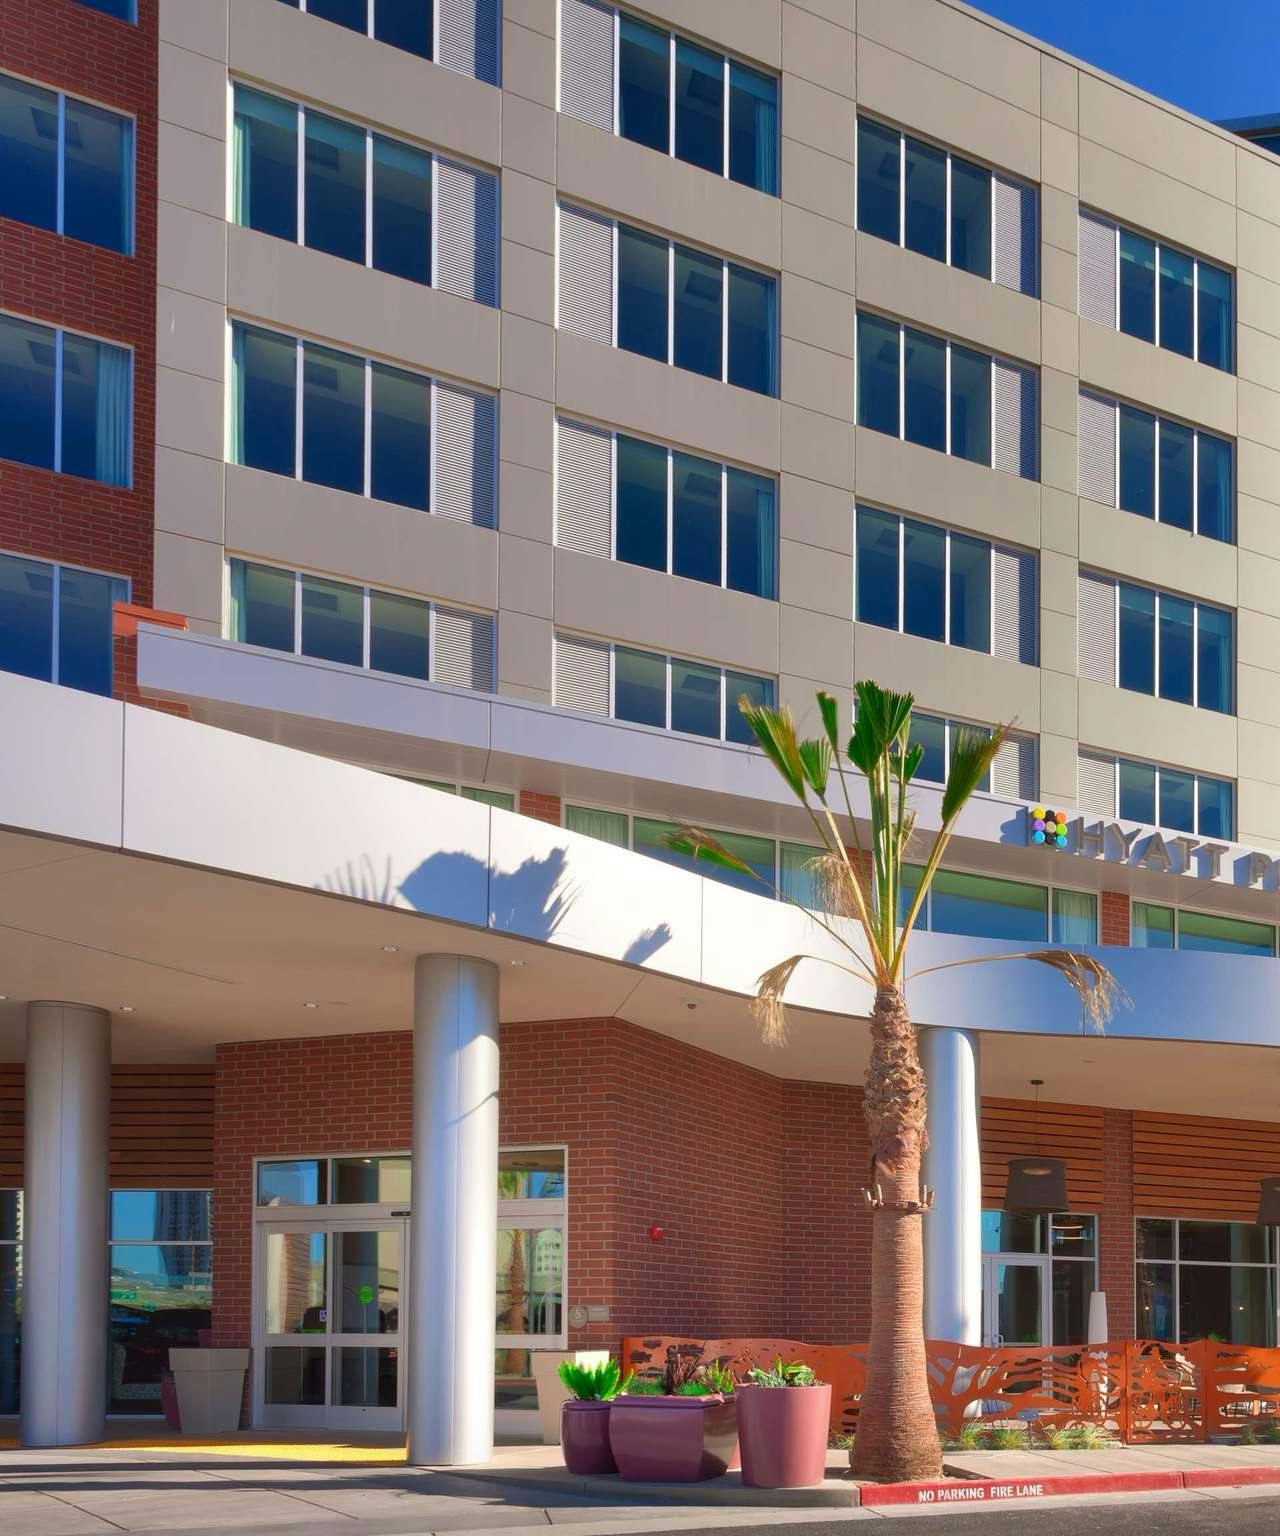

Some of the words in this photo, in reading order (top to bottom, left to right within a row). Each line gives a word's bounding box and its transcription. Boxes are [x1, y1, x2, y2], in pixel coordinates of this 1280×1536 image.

[1077, 816, 1229, 878] HYATT
[919, 1490, 934, 1502] NO
[938, 1487, 984, 1500] PARKING
[990, 1486, 1013, 1498] FIRE
[1016, 1484, 1043, 1496] LANE
